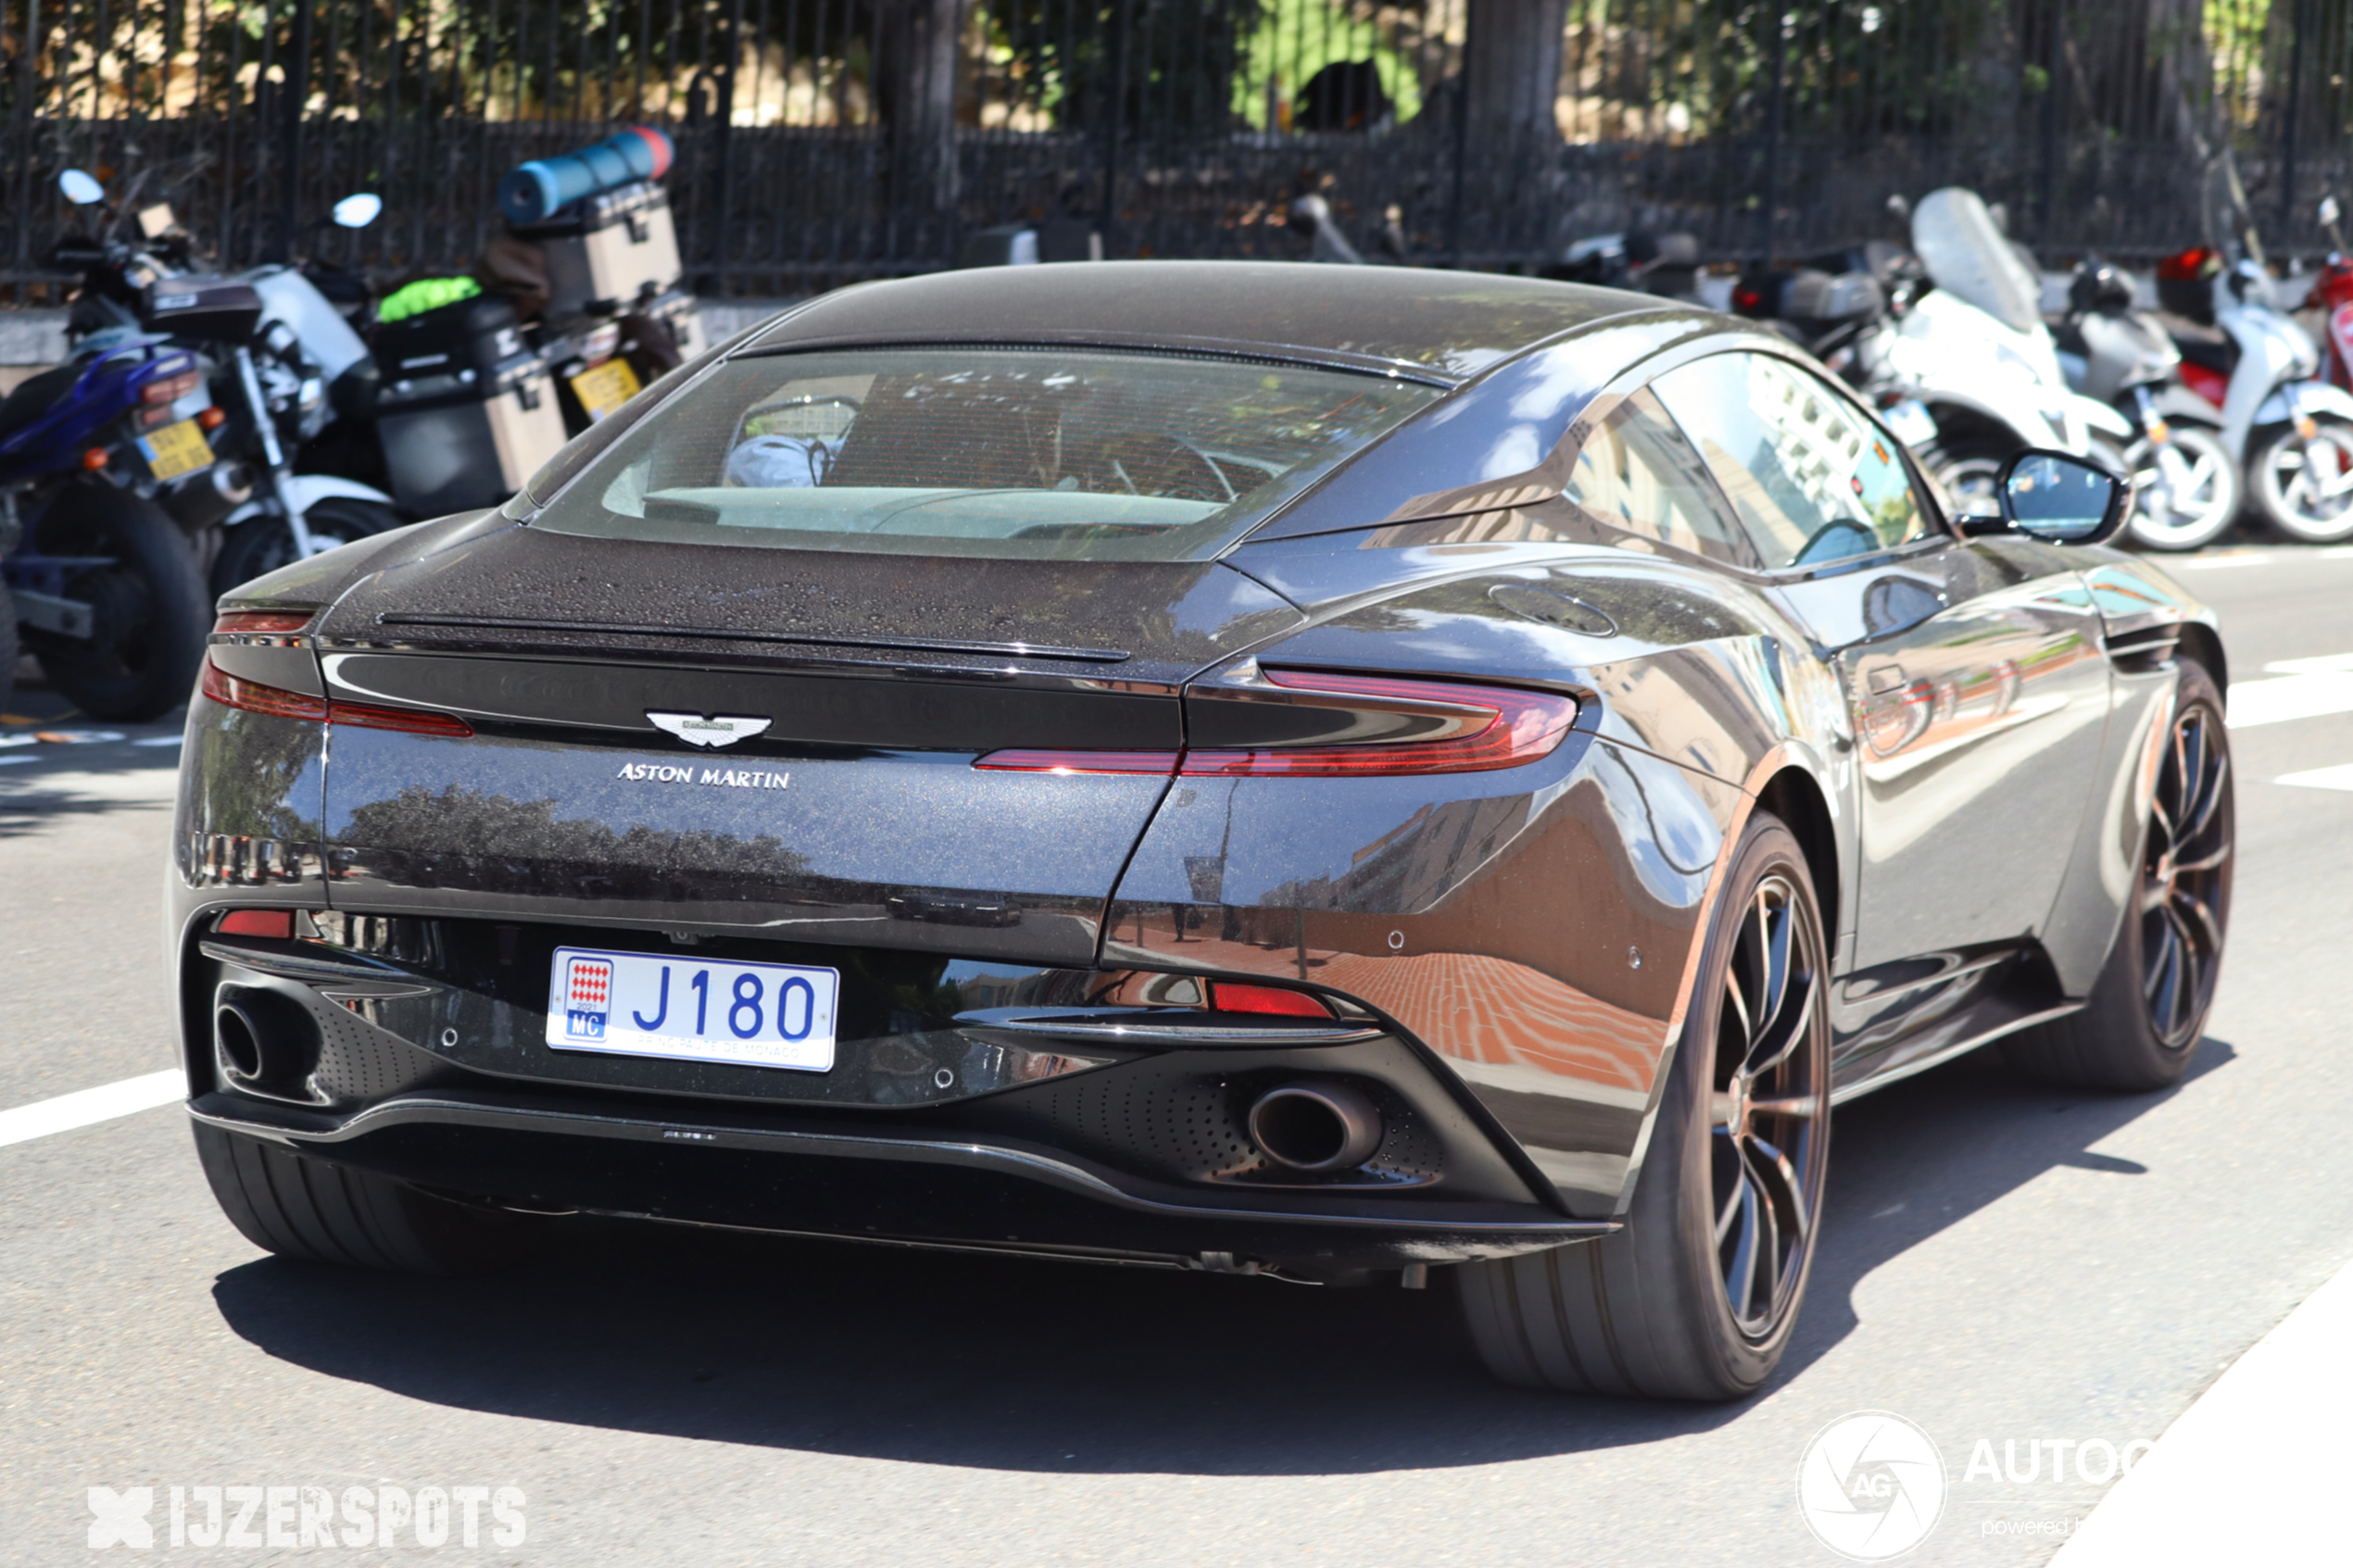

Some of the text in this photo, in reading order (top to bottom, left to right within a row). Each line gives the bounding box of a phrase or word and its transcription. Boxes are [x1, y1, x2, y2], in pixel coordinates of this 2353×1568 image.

[684, 721, 733, 730] ASTON MARTIN
[617, 763, 789, 789] ASTON MARTIN
[576, 1002, 597, 1011] 2021
[633, 966, 814, 1043] J180
[572, 1013, 599, 1035] MC
[724, 1042, 739, 1054] DE
[745, 1044, 799, 1059] MONACO
